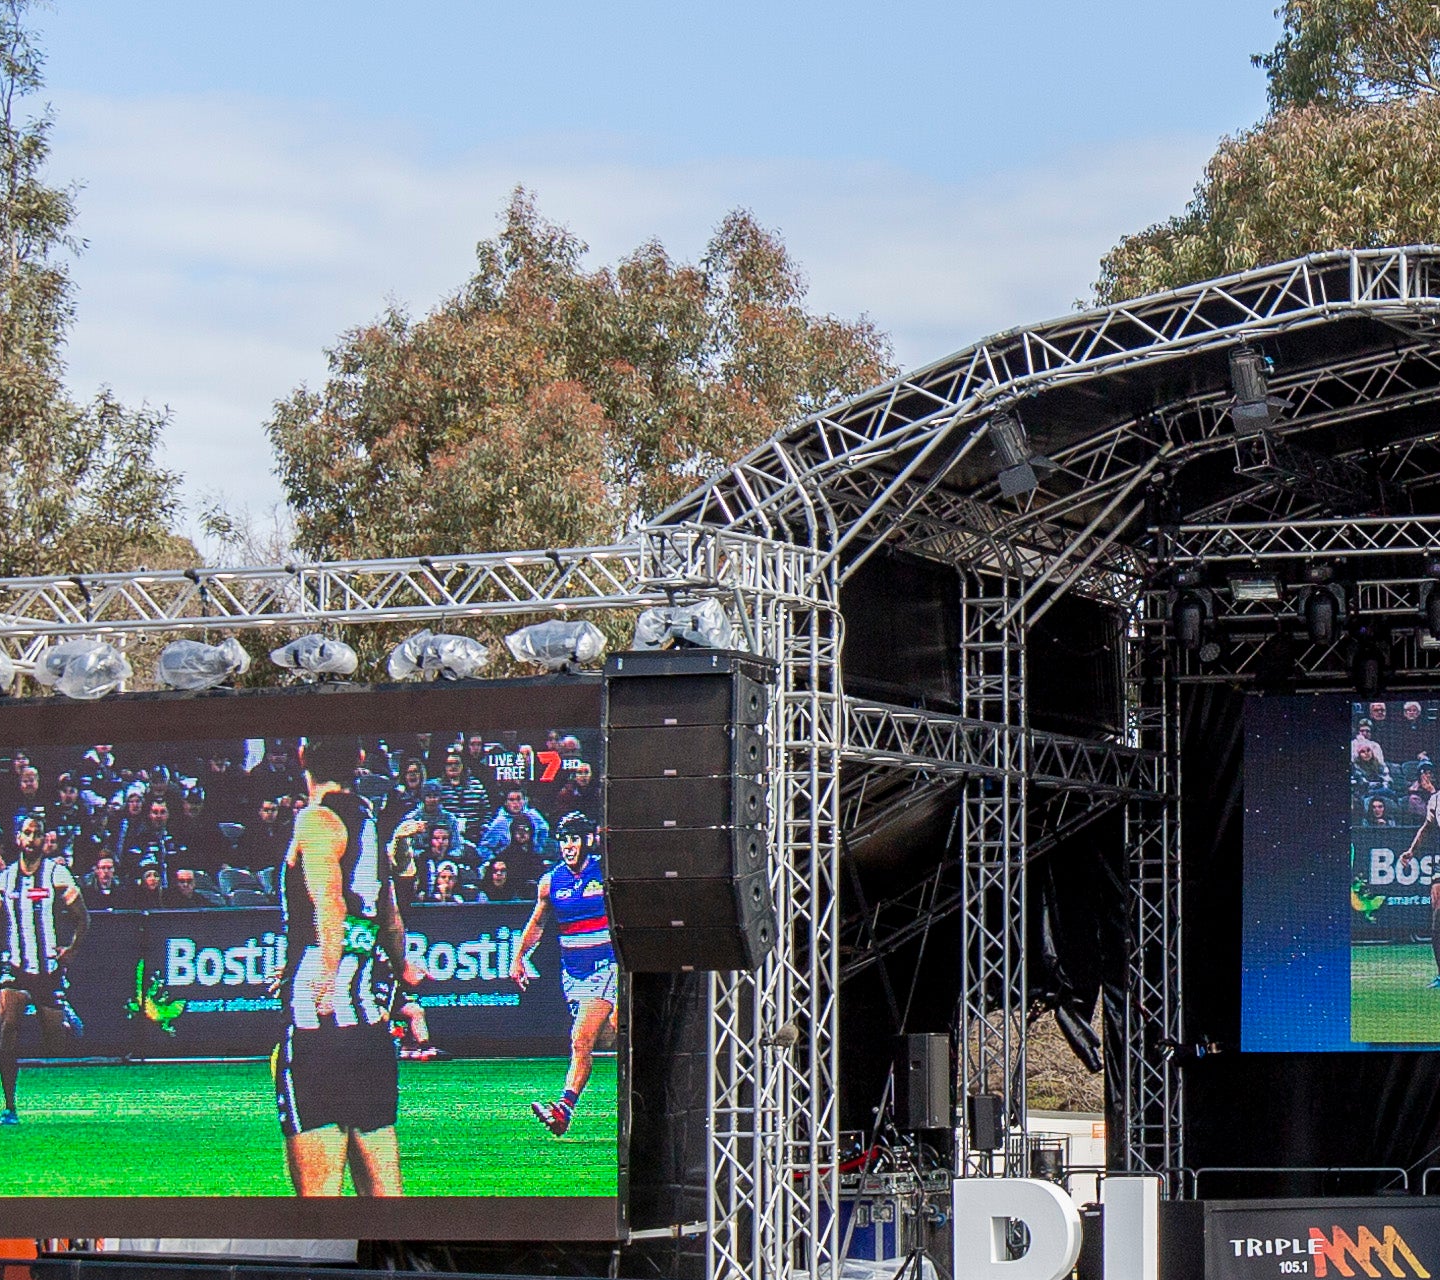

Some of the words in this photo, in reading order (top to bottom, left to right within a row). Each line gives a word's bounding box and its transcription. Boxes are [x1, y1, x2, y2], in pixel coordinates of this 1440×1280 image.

[488, 754, 514, 768] LIVE
[536, 751, 562, 783] 7
[496, 766, 525, 781] FREE
[1229, 1236, 1326, 1257] TRIPLE
[1278, 1261, 1309, 1275] 105.1
